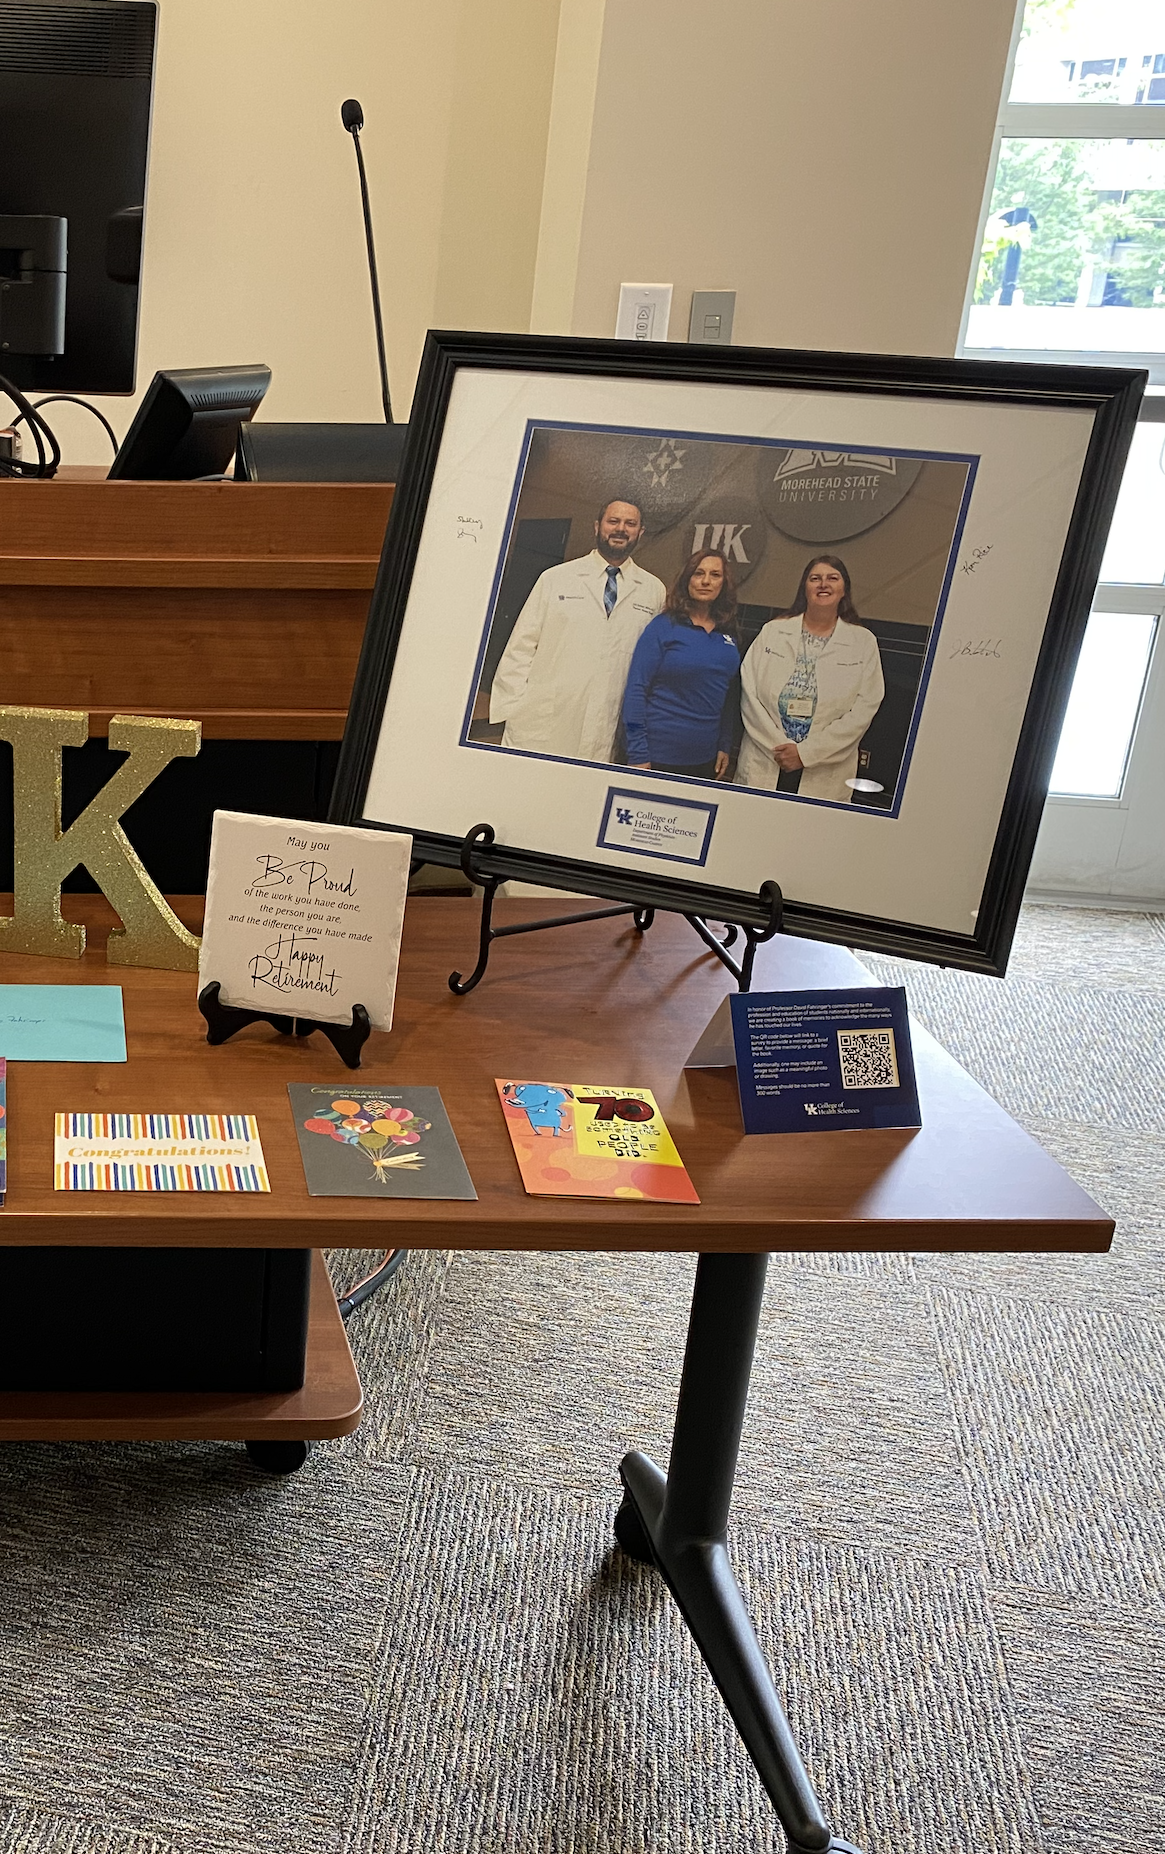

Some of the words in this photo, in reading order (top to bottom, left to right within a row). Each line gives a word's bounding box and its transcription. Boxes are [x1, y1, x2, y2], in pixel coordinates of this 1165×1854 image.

[781, 477, 842, 490] MOREHEAD
[843, 475, 880, 488] STATE
[779, 489, 879, 503] UNIVERSITY
[691, 523, 751, 564] UK
[636, 811, 666, 823] College
[667, 816, 678, 825] of
[634, 820, 662, 832] Health
[663, 824, 698, 838] Sciences
[287, 836, 308, 850] May
[310, 841, 331, 852] you
[251, 854, 306, 888] Be
[299, 860, 357, 897] Proud
[244, 887, 254, 897] of
[255, 889, 268, 899] the
[271, 891, 293, 902] work
[294, 895, 312, 905] you
[314, 897, 336, 908] have
[338, 901, 361, 913] done,
[259, 904, 274, 913] the
[275, 908, 305, 918] person
[307, 912, 324, 922] you
[326, 914, 342, 924] are,
[228, 913, 244, 923] and
[246, 915, 261, 926] the
[262, 918, 304, 932] difference
[306, 925, 323, 935] you
[325, 927, 346, 939] have
[348, 931, 373, 943] made
[265, 933, 325, 980] Happy
[248, 954, 343, 997] Retirement
[311, 1087, 382, 1096] Congratulations
[576, 1096, 655, 1122] 70
[597, 1140, 659, 1151] PEOPLE
[609, 1134, 640, 1142] OLD
[67, 1146, 251, 1159] Congratulations!
